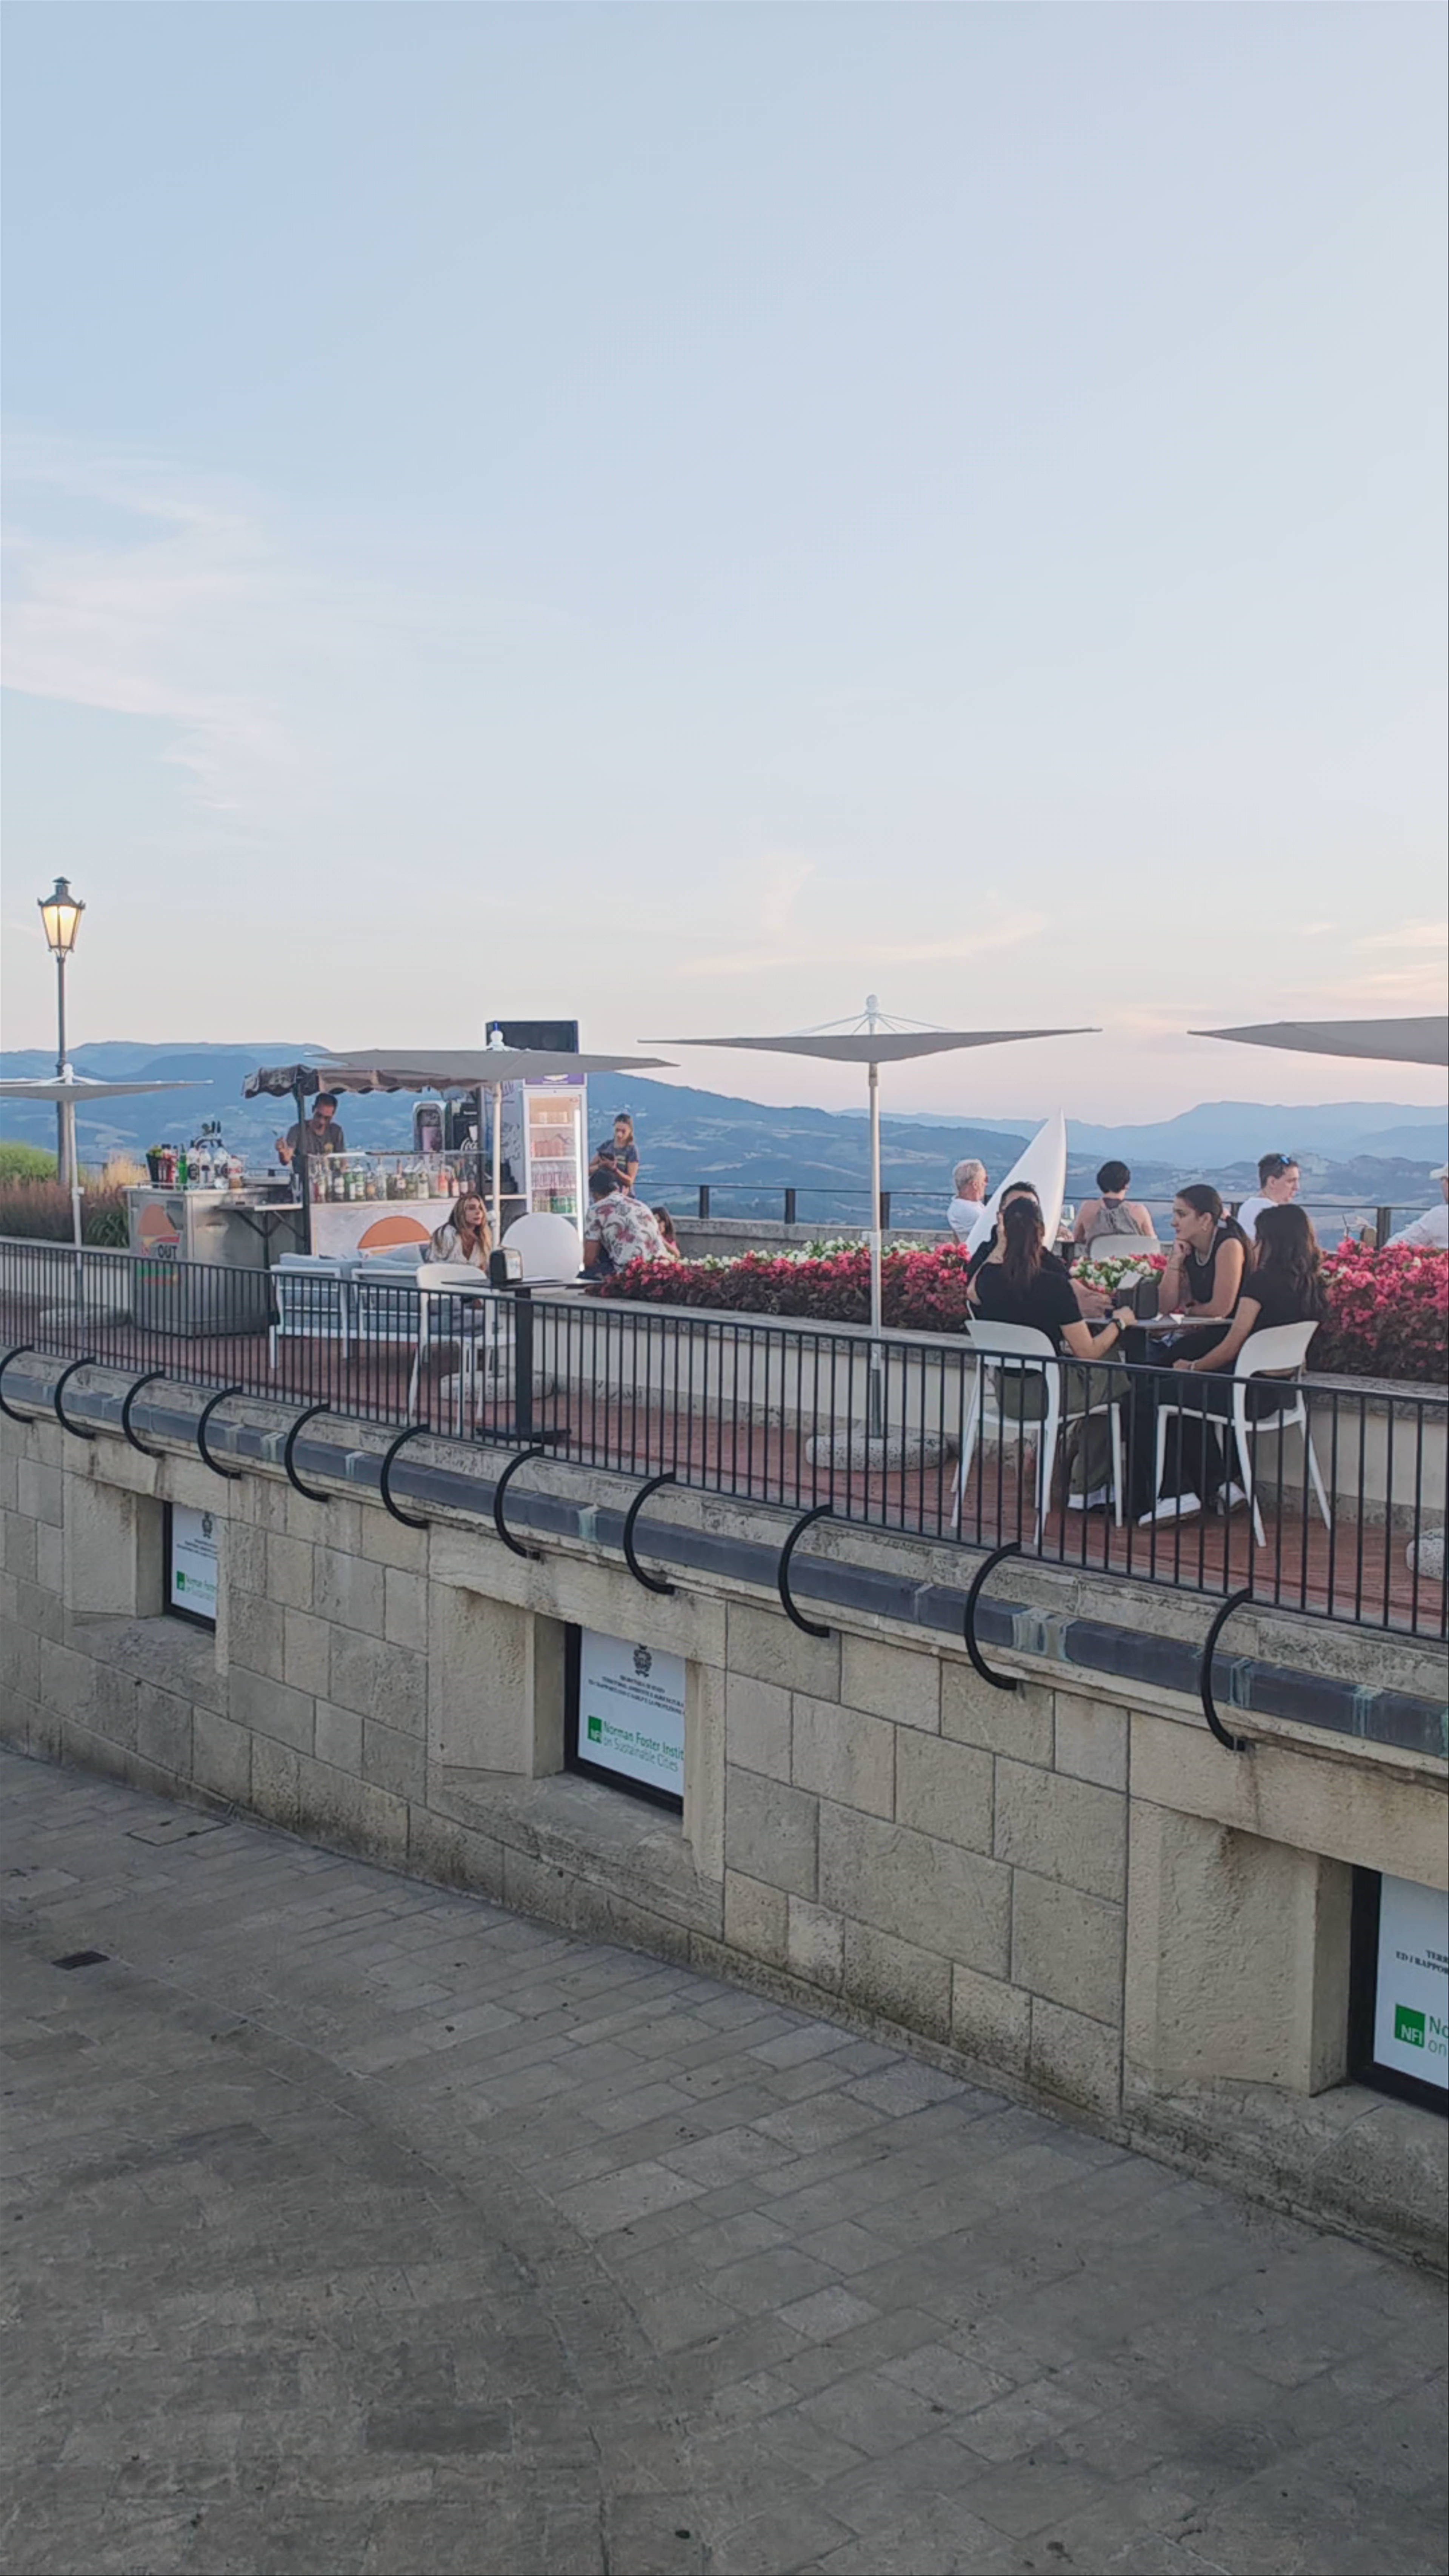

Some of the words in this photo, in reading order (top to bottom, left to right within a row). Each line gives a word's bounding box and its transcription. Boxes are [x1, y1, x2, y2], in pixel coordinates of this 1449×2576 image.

[158, 1244, 177, 1260] OUT
[604, 1721, 634, 1742] Norman
[636, 1731, 660, 1751] Foster
[614, 1738, 655, 1764] Sustainable
[657, 1753, 678, 1772] Cities
[1401, 2024, 1423, 2045] NFI
[1428, 2039, 1447, 2056] on
